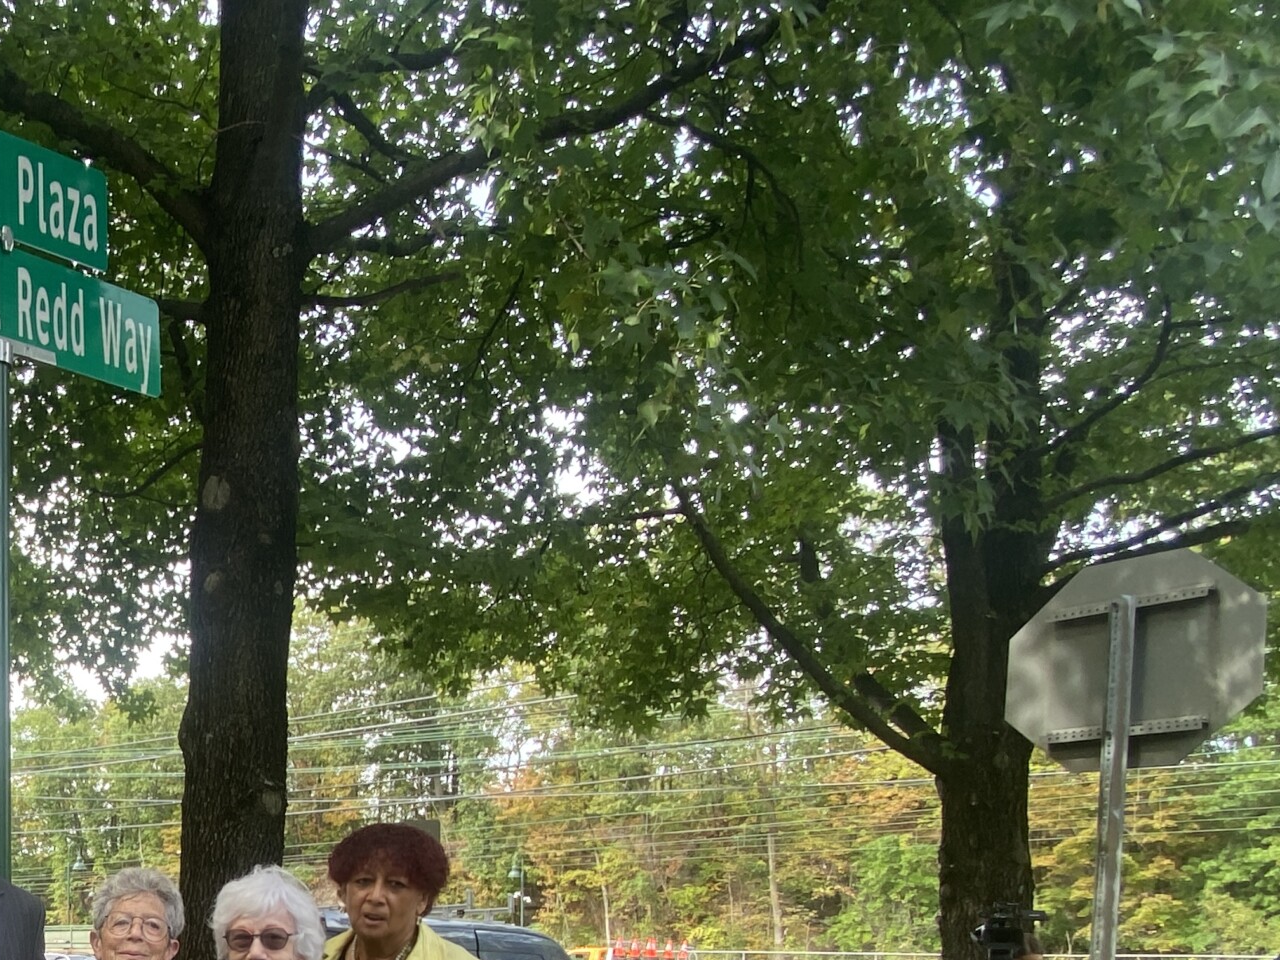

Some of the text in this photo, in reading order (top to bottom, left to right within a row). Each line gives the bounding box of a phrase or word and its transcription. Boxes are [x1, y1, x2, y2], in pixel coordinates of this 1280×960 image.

[18, 155, 99, 253] Plaza
[17, 266, 85, 357] Redd
[99, 296, 152, 394] Way
